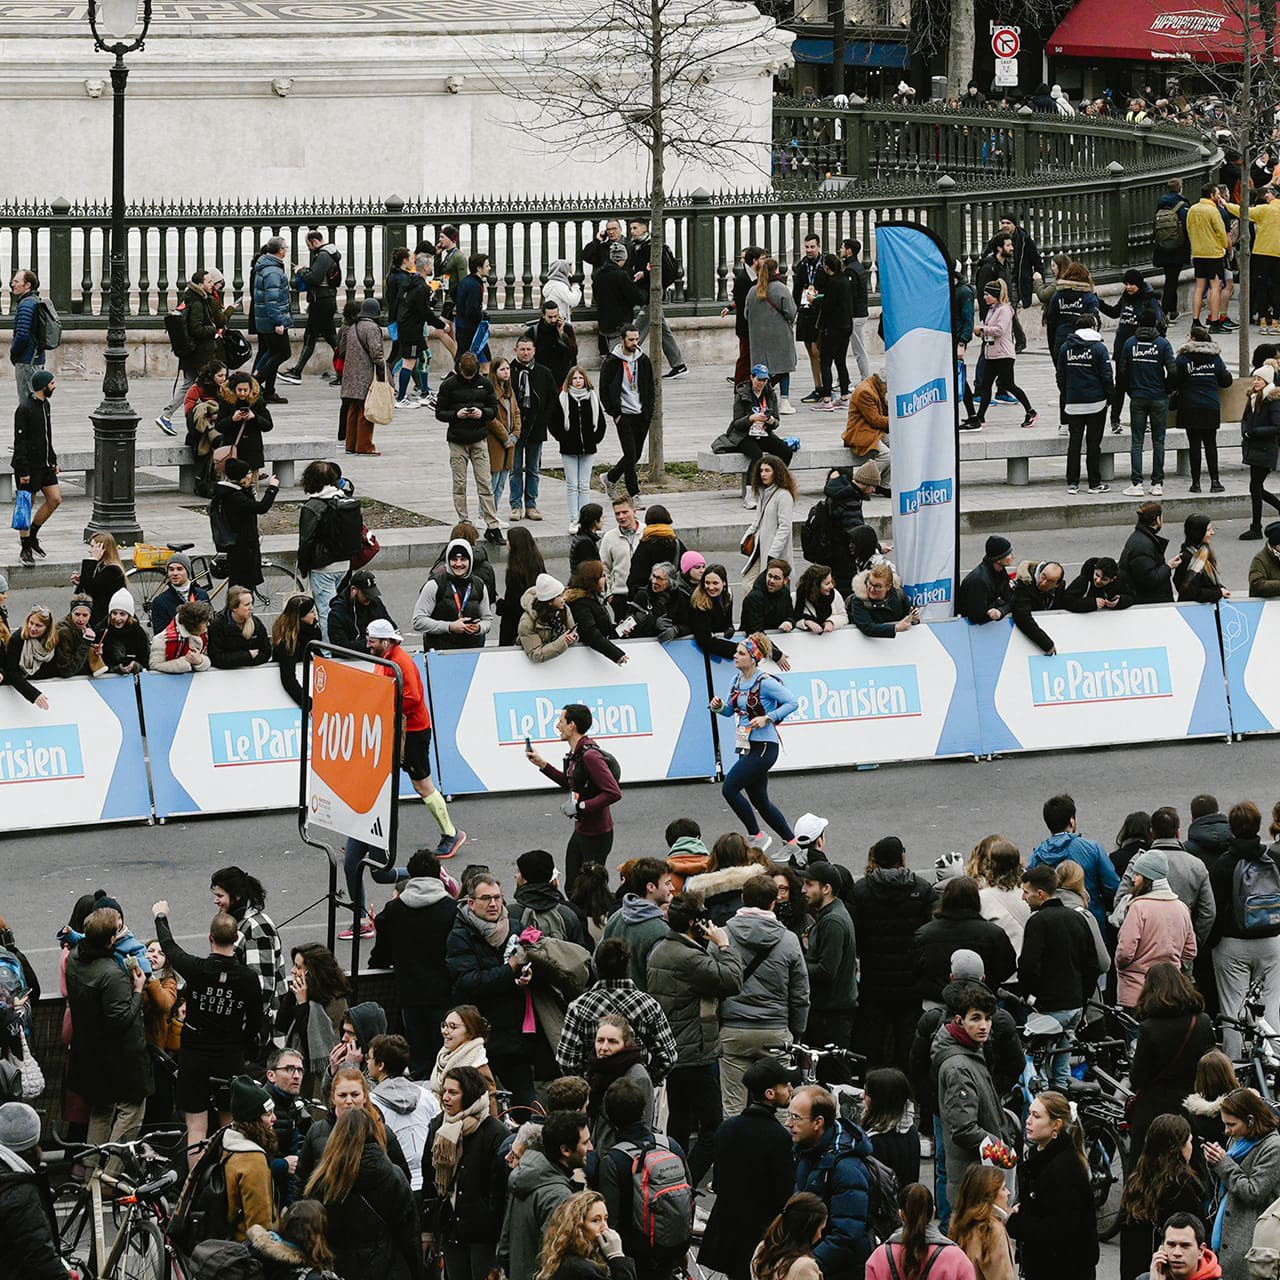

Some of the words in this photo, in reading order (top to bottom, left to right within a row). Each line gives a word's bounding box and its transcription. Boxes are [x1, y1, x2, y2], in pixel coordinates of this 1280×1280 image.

[1043, 671, 1065, 701] Le
[1066, 659, 1159, 699] Parisien
[811, 678, 907, 719] Parisien
[318, 711, 355, 762] 100
[361, 712, 382, 769] M
[509, 708, 534, 740] Le
[224, 729, 250, 762] Le
[192, 991, 244, 1009] SPORTS
[206, 986, 233, 998] BDS
[200, 1002, 233, 1016] CLUB
